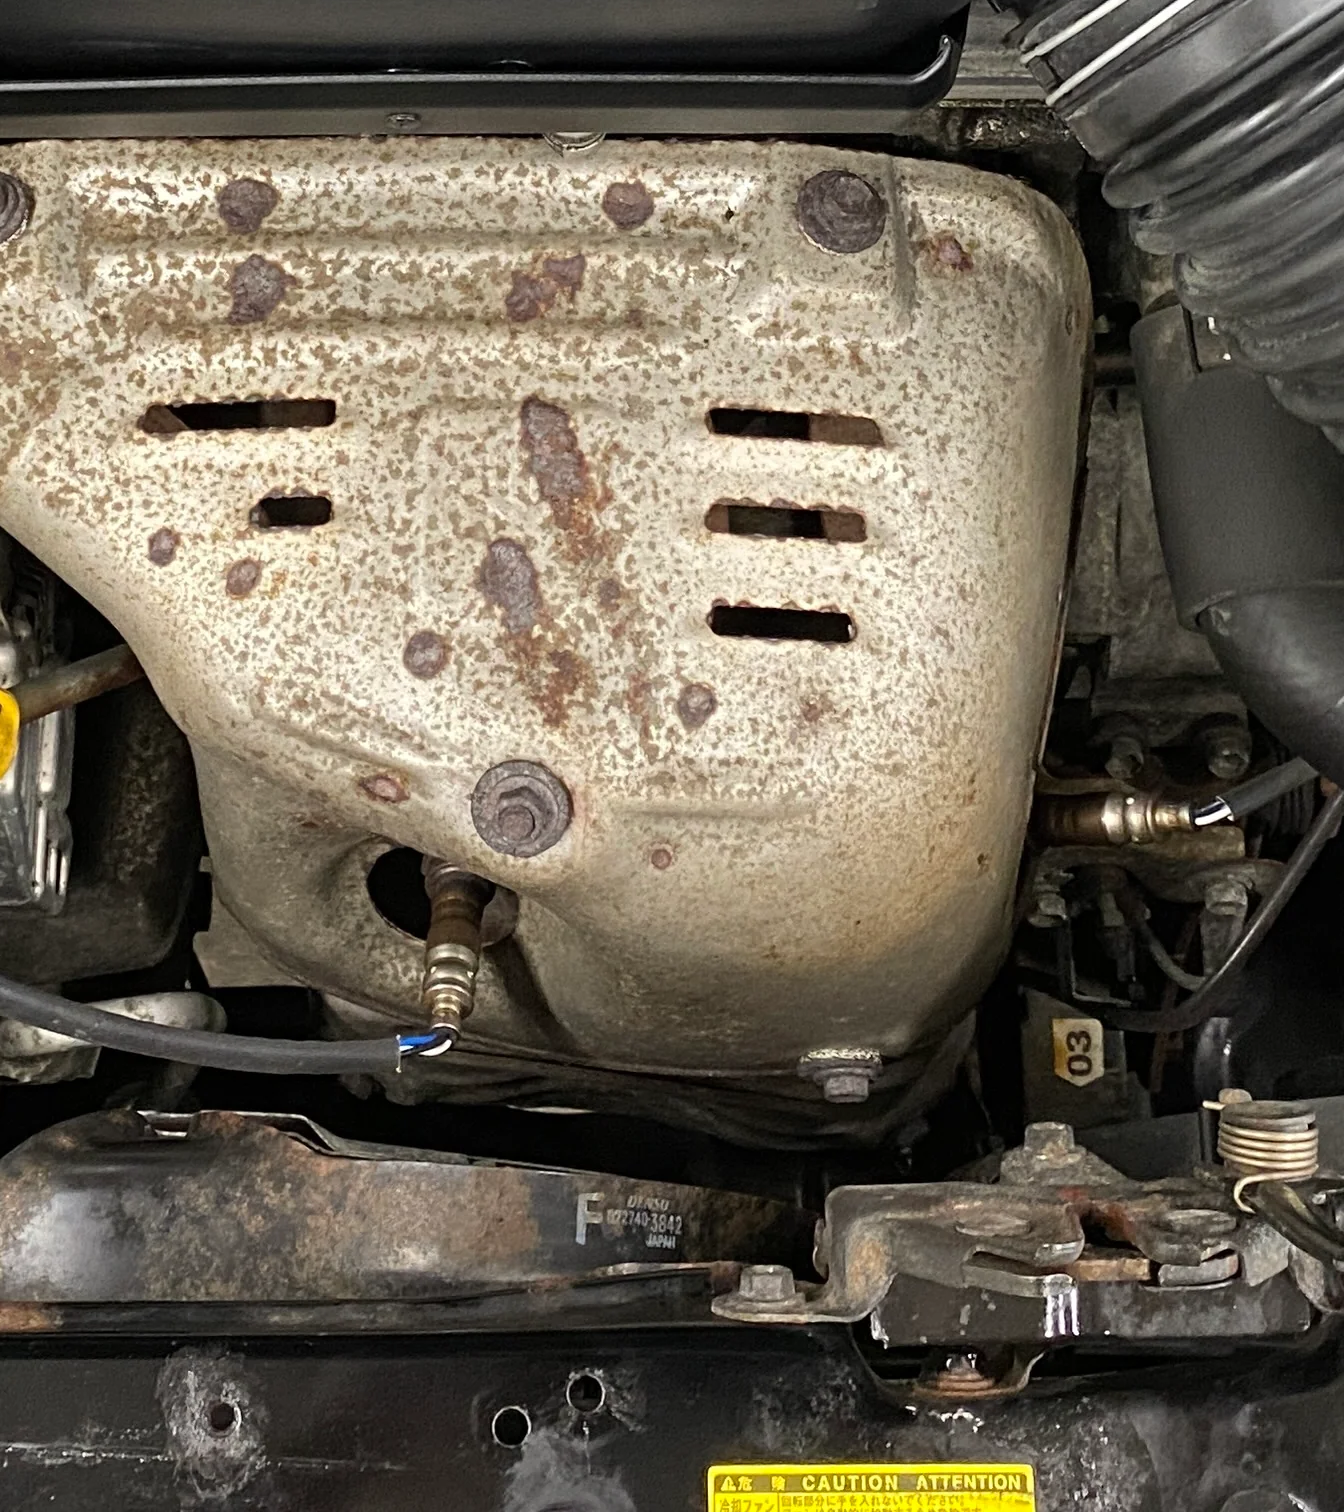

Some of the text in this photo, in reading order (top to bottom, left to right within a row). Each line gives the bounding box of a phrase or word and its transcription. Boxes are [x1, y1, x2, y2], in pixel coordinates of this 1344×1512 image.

[1066, 1030, 1093, 1077] 03
[576, 1192, 605, 1246] F
[802, 1474, 1021, 1492] CAUTION ATTENTION
